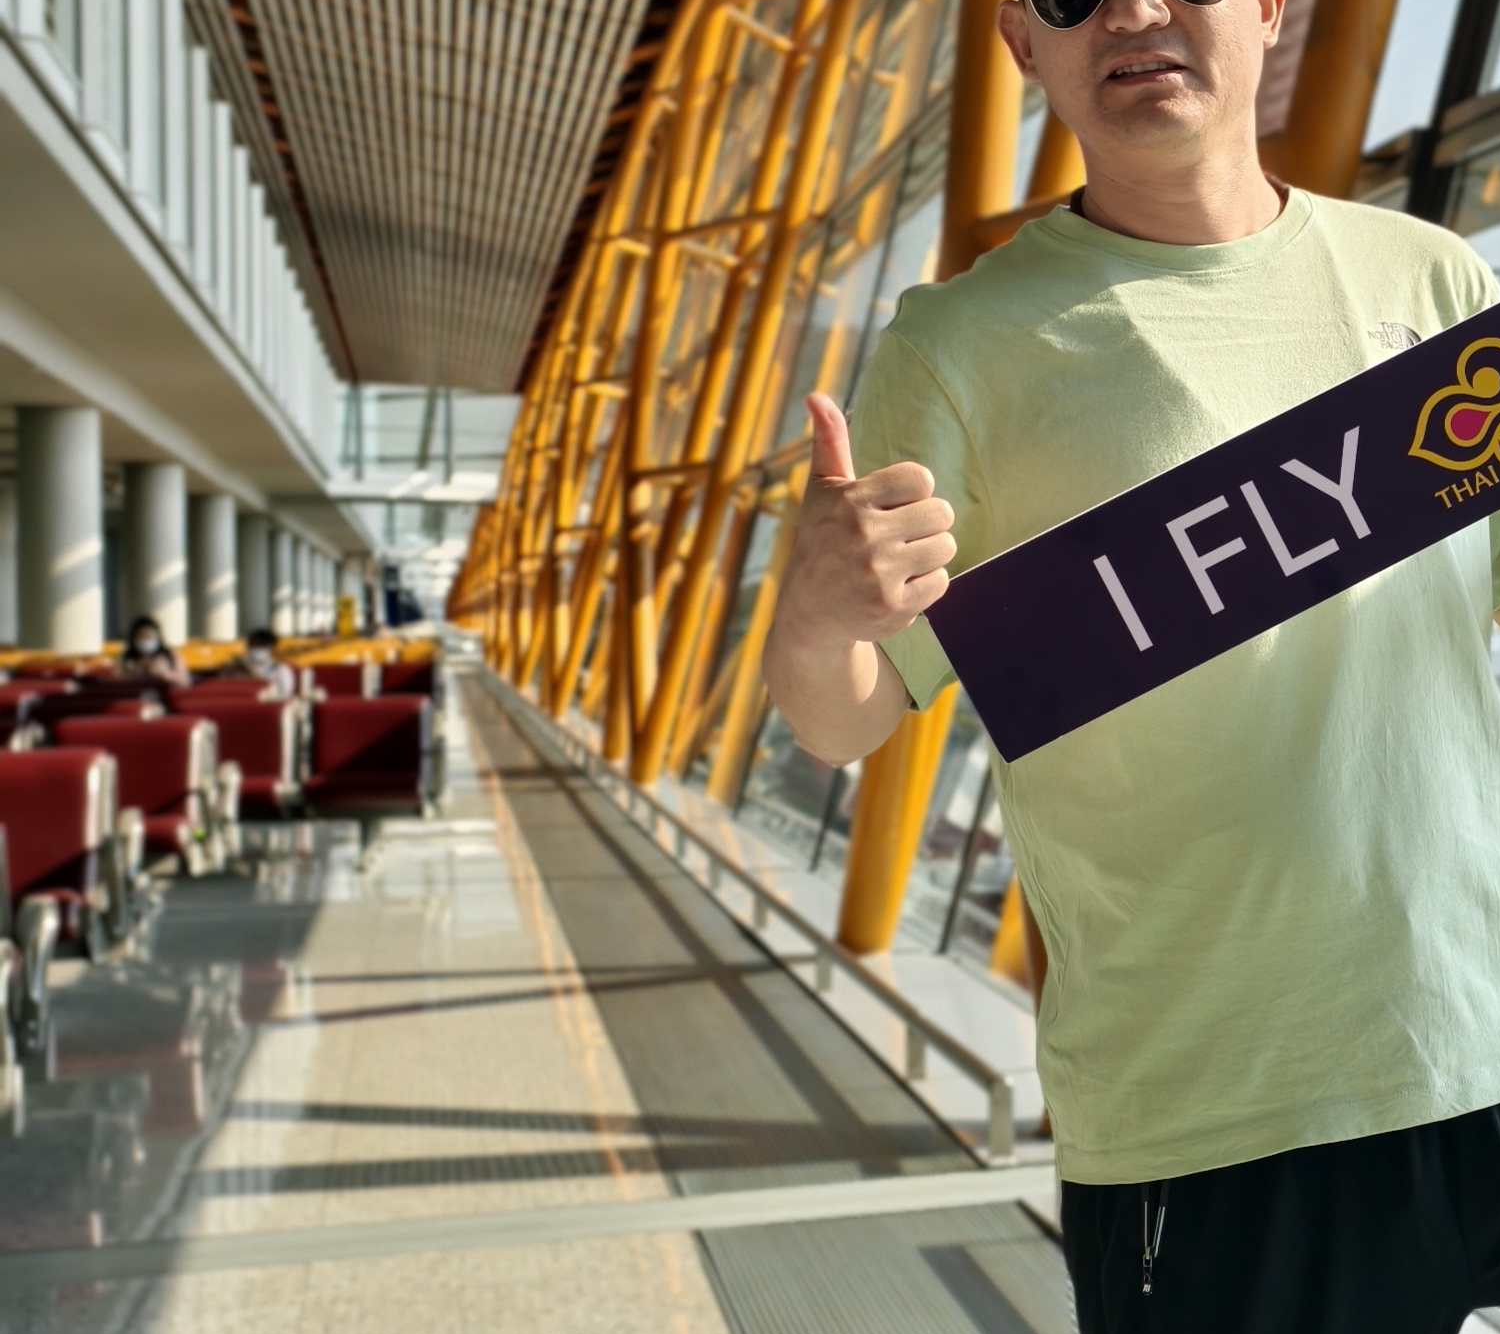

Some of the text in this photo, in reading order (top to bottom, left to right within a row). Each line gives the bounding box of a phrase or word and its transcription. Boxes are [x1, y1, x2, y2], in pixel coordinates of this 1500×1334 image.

[1093, 425, 1372, 652] I FLY
[1434, 465, 1500, 509] THAI
